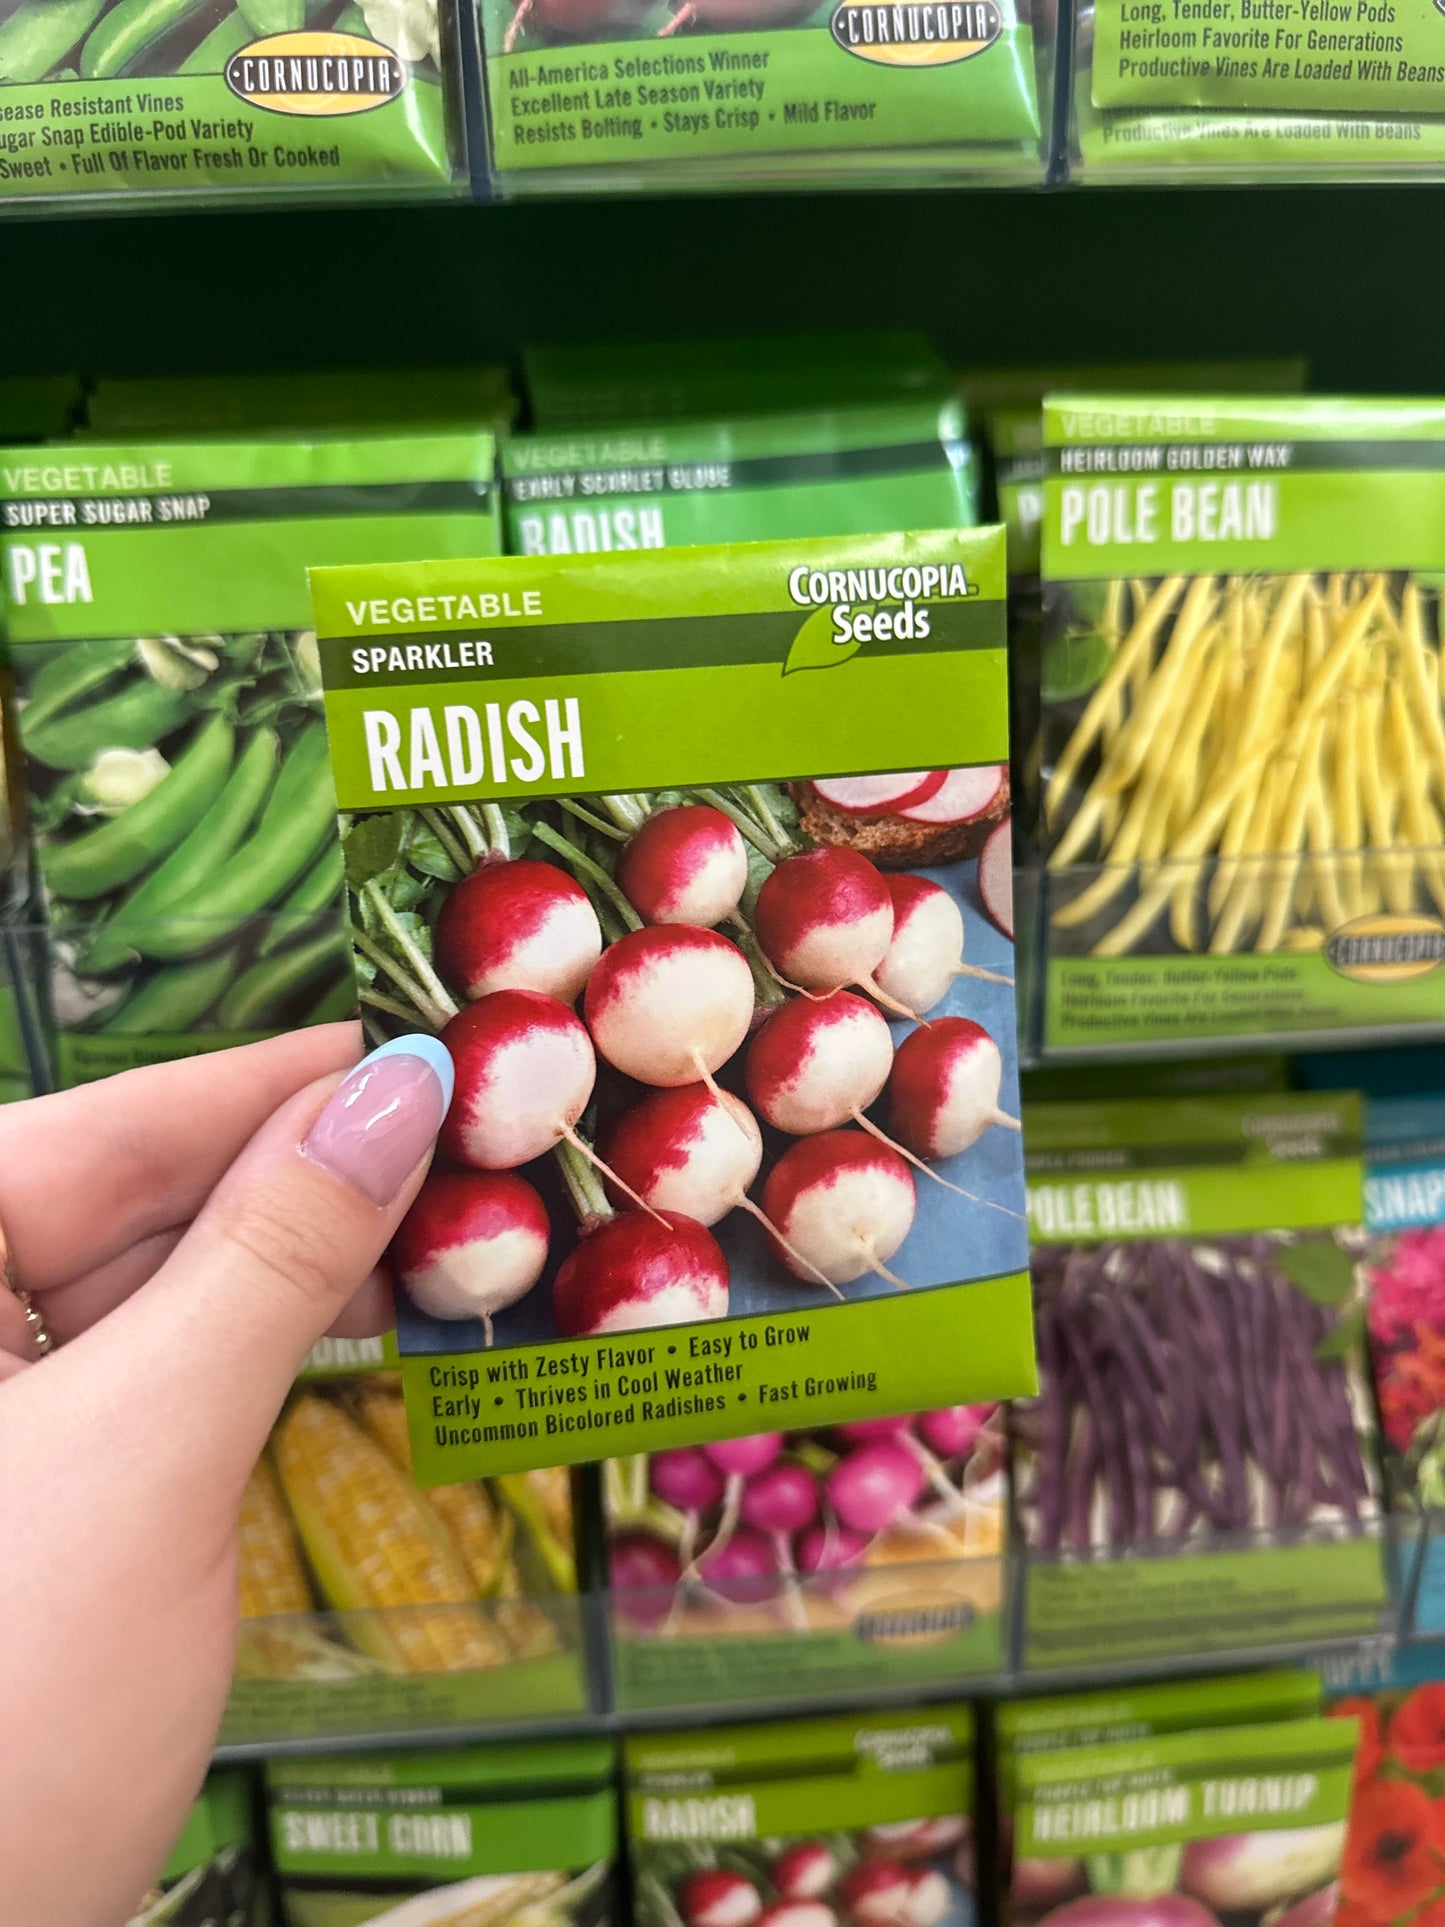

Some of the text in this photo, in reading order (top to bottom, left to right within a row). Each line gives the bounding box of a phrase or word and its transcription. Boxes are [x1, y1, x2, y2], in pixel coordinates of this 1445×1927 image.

[847, 4, 987, 44] CORNUCOPIA
[1120, 0, 1396, 24] Long, Tender, Butter-Yellow Pods
[1119, 27, 1403, 52] Heirloom Favorite For Generations
[242, 57, 391, 93] CORNUCOPIA
[509, 51, 770, 90] All-America Selections Winner
[1118, 56, 1444, 83] Productive Vines Are Loaded With Beans
[50, 95, 133, 118] Resistant
[136, 93, 184, 112] Vines
[511, 79, 765, 117] Excellent Late Season Variety
[41, 126, 84, 148] Snap
[90, 119, 187, 143] Edible-Pod
[191, 119, 253, 142] Variety
[513, 100, 876, 146] Resists Bolting Stays Crisp Mild Flavor
[0, 145, 340, 179] Sweet Full Of Flavor Fresh Or Cooked
[1060, 412, 1216, 438] VEGETABLE
[1061, 447, 1160, 473] HEIRLOOM
[1167, 447, 1241, 470] GOLDEN
[1247, 444, 1289, 468] WAX
[2, 463, 173, 493] VEGETABLE
[6, 494, 211, 526] SUPER SUGAR SNAP
[1060, 485, 1157, 546] POLE
[1171, 483, 1275, 543] BEAN
[521, 507, 666, 556] RADISH
[10, 544, 94, 606] PEA
[788, 563, 968, 605] CORNUCOPIA
[346, 591, 543, 626] VEGETABLE
[831, 600, 931, 645] Seeds
[351, 641, 494, 674] SPARKLER
[362, 697, 585, 792] RADISH
[1096, 1180, 1182, 1231] BEAN
[430, 1325, 810, 1390] Crisp with Zesty Flavor Easy to Grow
[433, 1362, 743, 1420] Early Thrives in Cool Weather
[436, 1370, 878, 1446] Uncommon Bicolored Radishes Fast Growing
